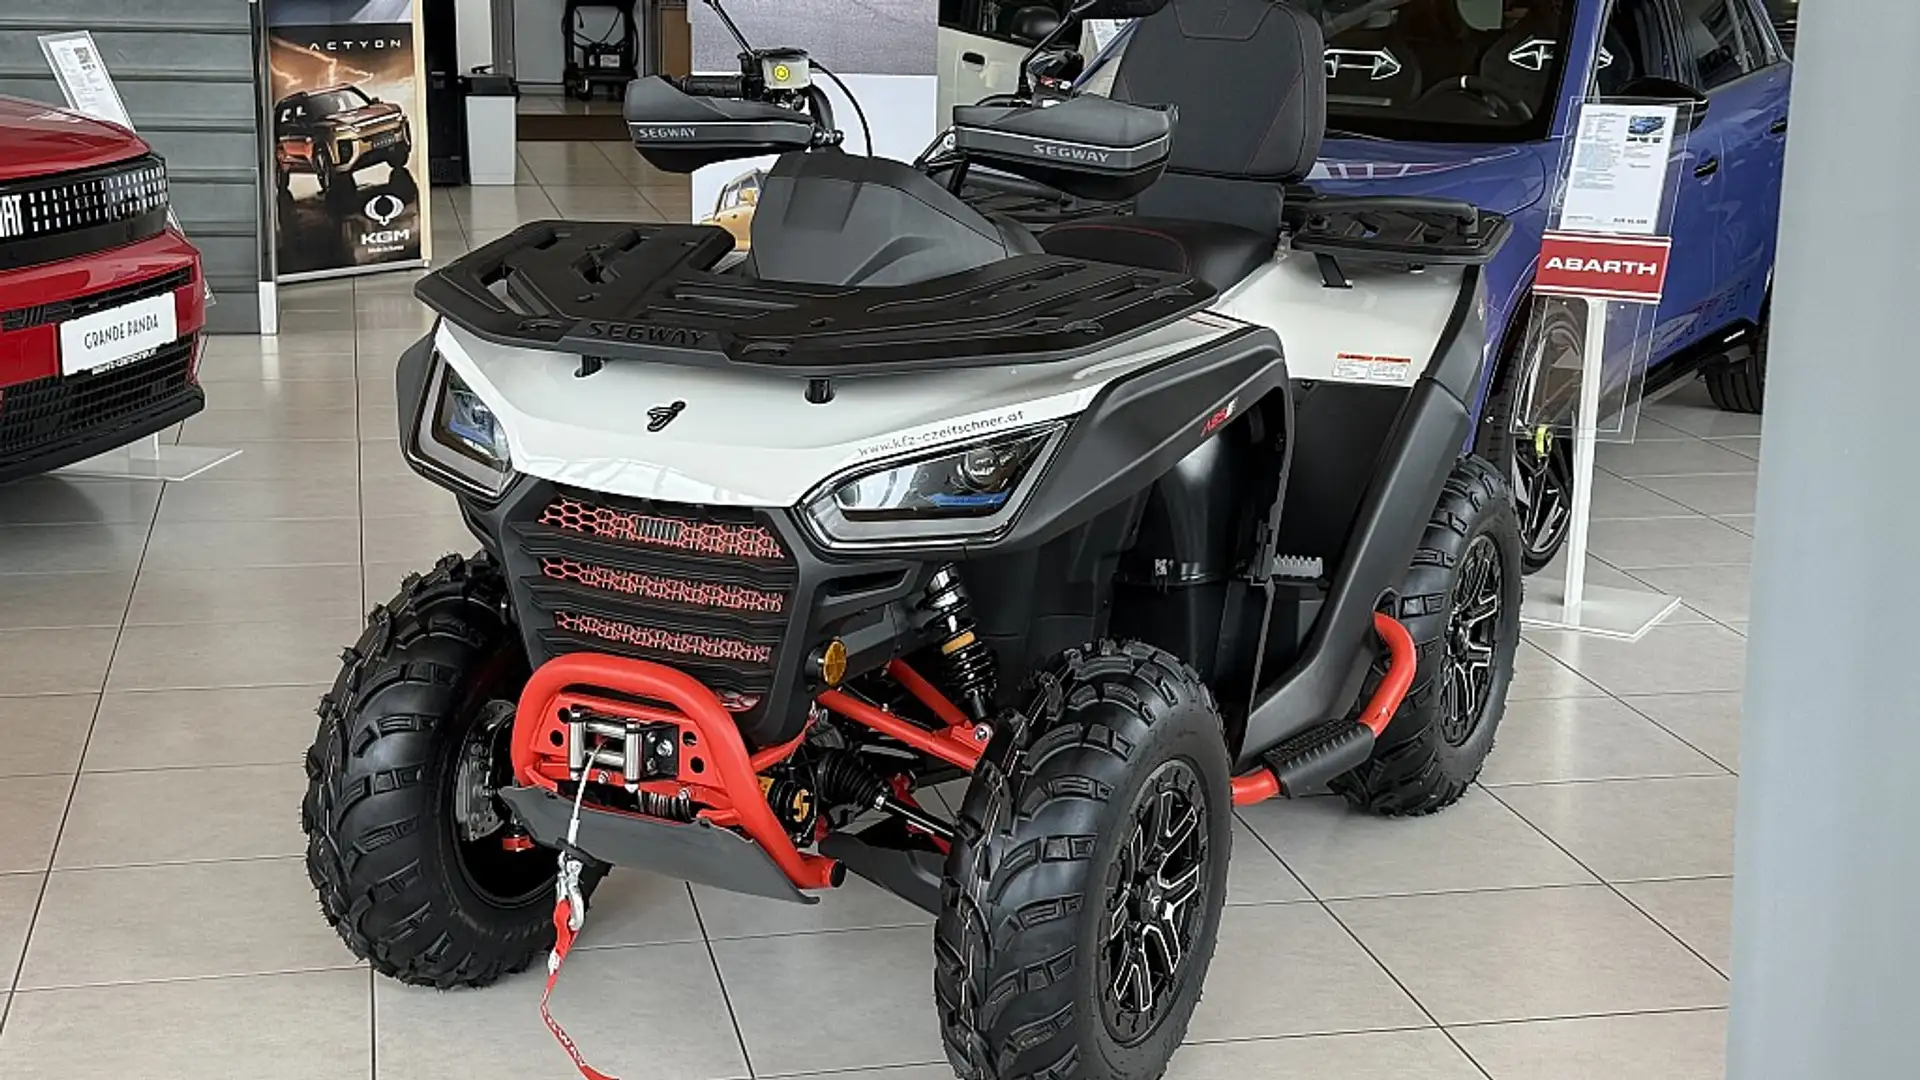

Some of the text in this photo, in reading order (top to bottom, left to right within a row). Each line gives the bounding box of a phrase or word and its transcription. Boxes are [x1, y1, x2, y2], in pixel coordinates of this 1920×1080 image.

[309, 39, 402, 51] ACTYON
[638, 126, 698, 139] SEGWAY
[1032, 143, 1110, 163] SEGWAY
[0, 194, 24, 238] AT
[360, 228, 411, 246] KGM
[1544, 256, 1658, 276] ABARTH
[83, 312, 160, 351] GRANDE PANDA
[585, 319, 709, 346] SEGWAY
[856, 408, 1026, 458] www.kfz-czeitschner.at
